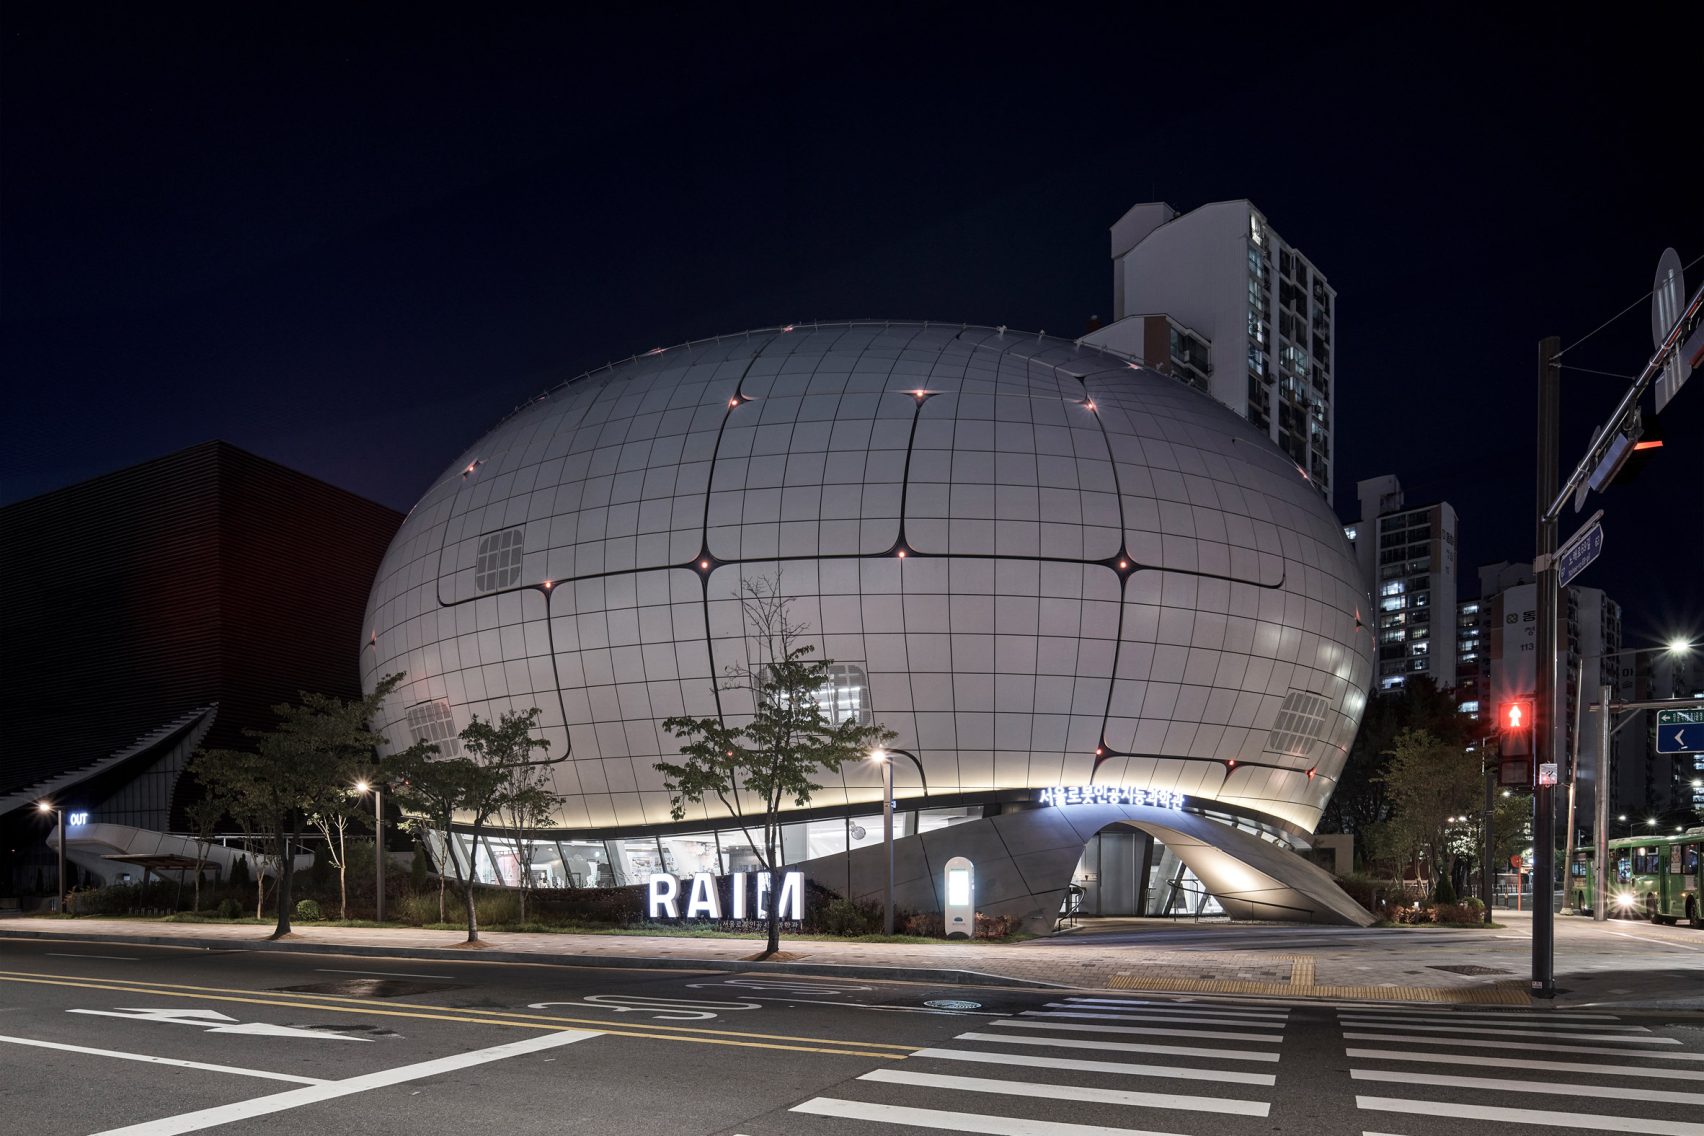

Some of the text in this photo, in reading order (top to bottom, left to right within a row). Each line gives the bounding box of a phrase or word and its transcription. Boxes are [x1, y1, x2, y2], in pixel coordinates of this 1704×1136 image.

[1039, 785, 1185, 811] 서울로봇인공지능과학관
[70, 813, 88, 825] OUT
[649, 872, 804, 919] RAIM
